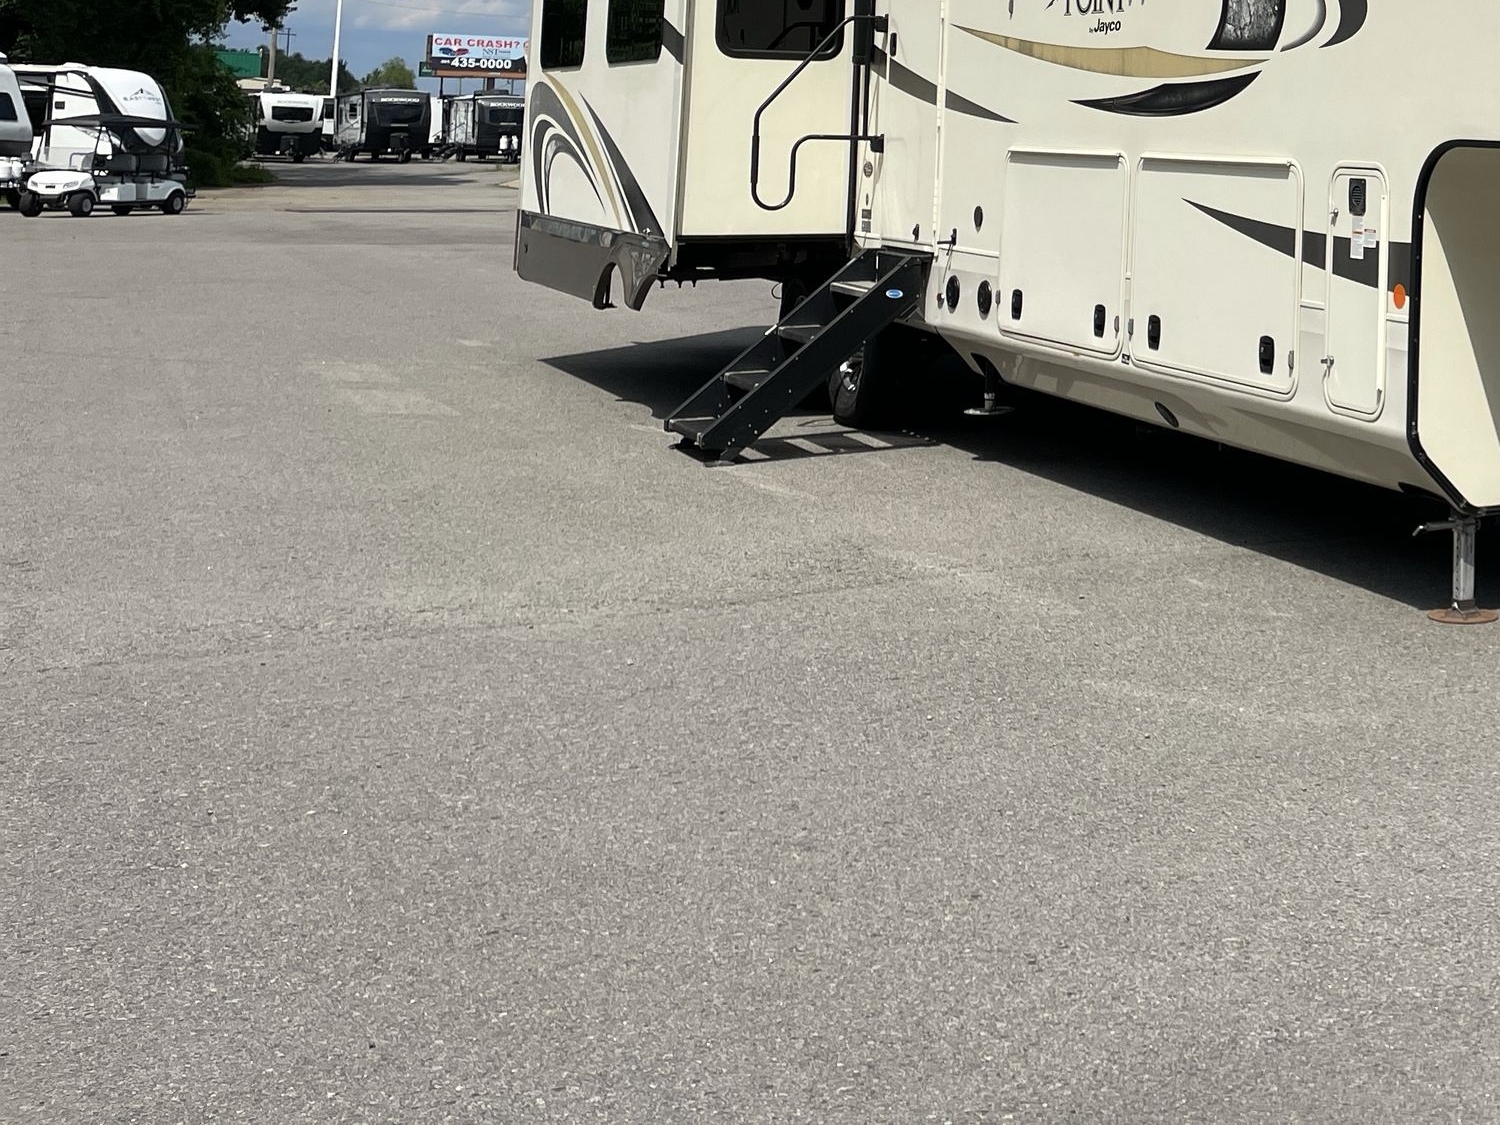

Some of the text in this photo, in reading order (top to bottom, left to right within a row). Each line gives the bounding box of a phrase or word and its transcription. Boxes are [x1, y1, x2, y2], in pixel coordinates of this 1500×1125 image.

[1093, 18, 1121, 35] Jayco
[434, 37, 520, 49] CAR CRASH?
[450, 57, 512, 69] 435-0000
